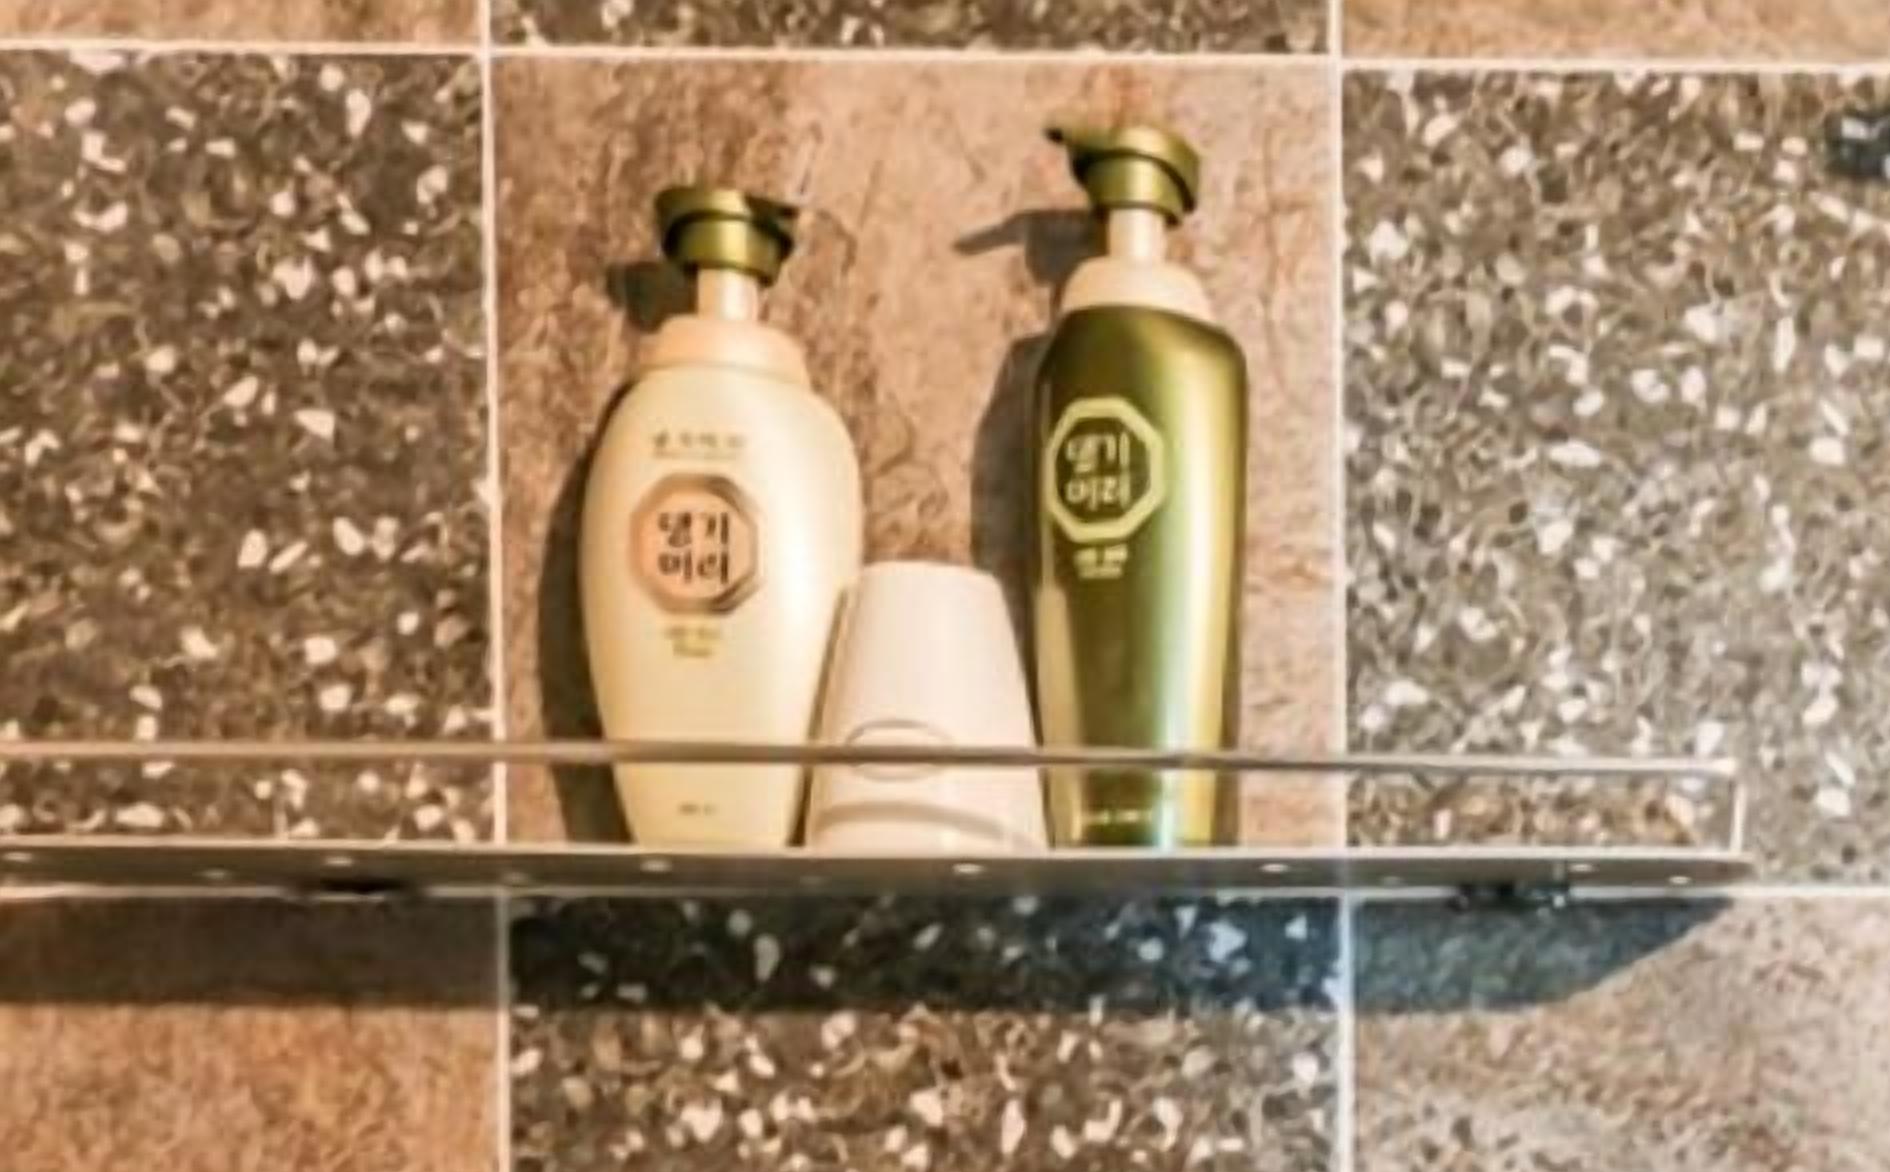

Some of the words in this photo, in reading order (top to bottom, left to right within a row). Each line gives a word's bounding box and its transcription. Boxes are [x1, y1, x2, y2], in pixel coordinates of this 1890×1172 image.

[1064, 471, 1131, 511] 머리
[656, 510, 730, 549] 댕기
[656, 546, 730, 584] 머리
